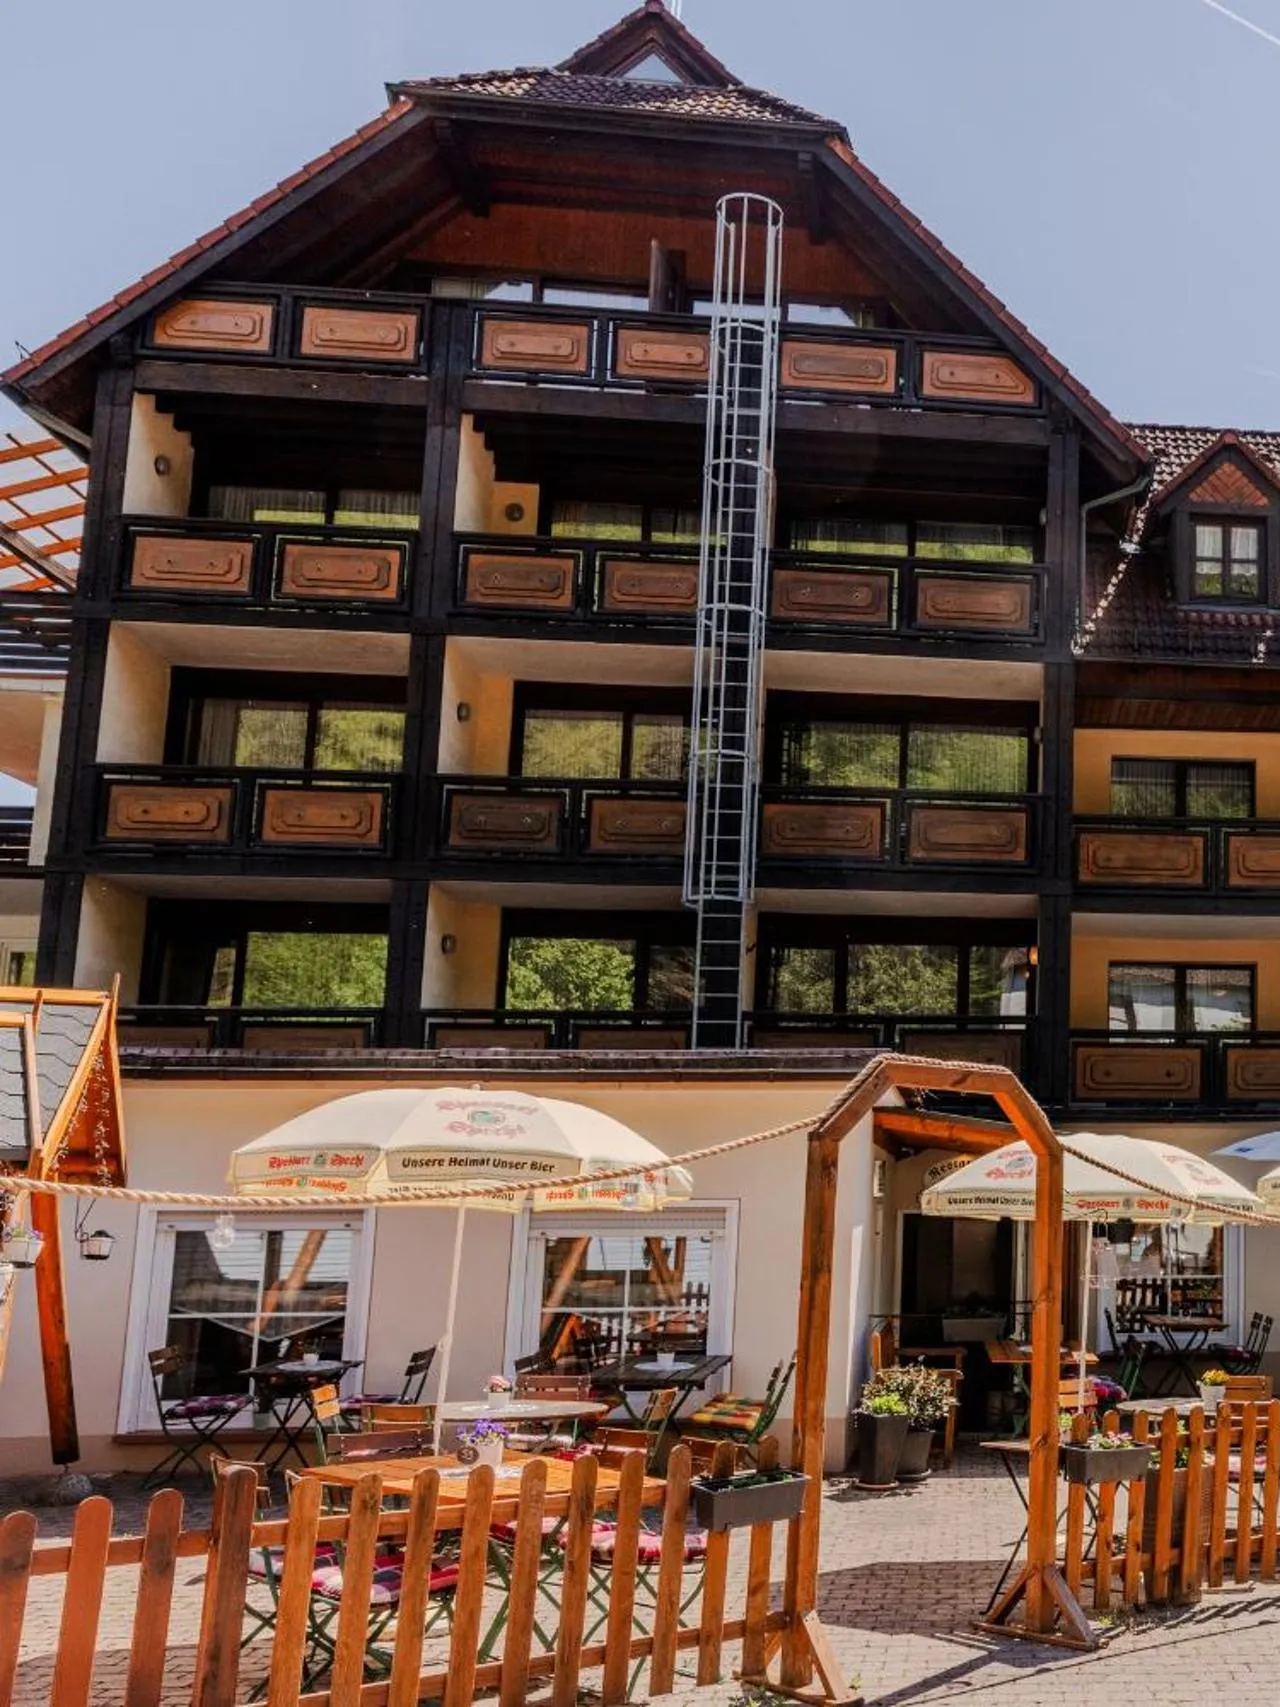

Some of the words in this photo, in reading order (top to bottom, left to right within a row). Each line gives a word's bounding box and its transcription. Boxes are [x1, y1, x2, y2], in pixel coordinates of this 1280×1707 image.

[402, 1157, 444, 1168] Unsere
[448, 1156, 490, 1167] Heimat
[493, 1157, 528, 1170] Unser
[530, 1160, 555, 1173] Bier
